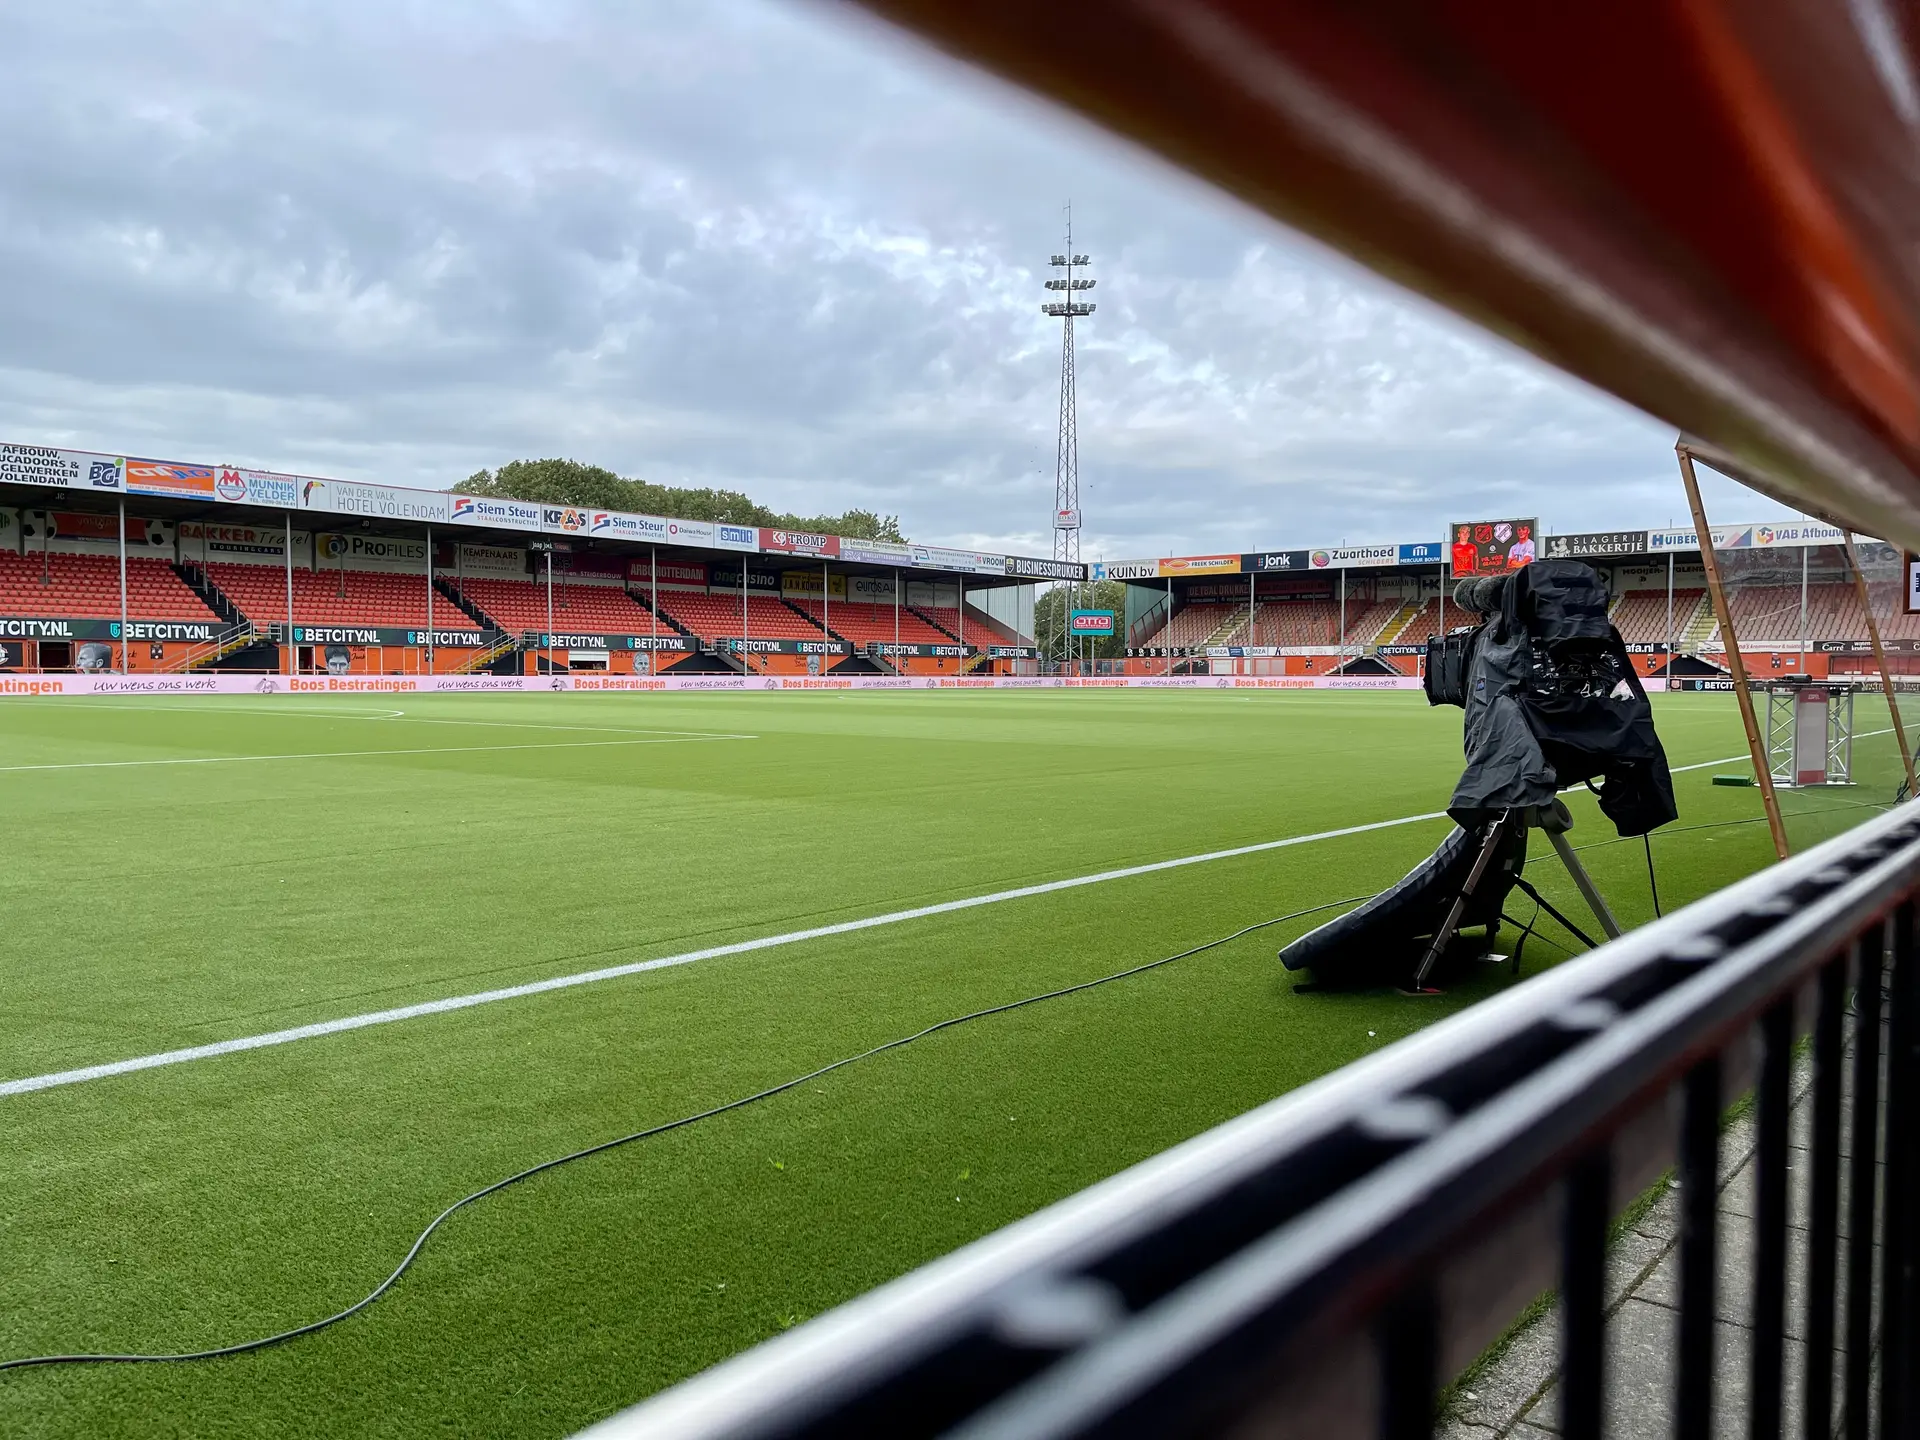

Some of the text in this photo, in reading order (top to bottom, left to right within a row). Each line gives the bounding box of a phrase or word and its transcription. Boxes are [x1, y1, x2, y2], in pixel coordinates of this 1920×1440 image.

[2, 446, 61, 459] AFBOUW,
[70, 461, 80, 469] &
[250, 479, 295, 492] MUNNIK
[250, 488, 296, 501] VELDER
[336, 486, 395, 501] VAN DER VALK
[337, 498, 445, 520] HOTEL VOLENDAM
[477, 502, 538, 519] Siem Steur
[477, 515, 539, 526] STAALCONSTRUCTIES
[613, 517, 665, 532] Siem Steur
[180, 524, 257, 543] BAKKER
[721, 527, 753, 543] smit
[1573, 533, 1643, 545] SLAGERIJ
[1652, 534, 1697, 545] HUIBER
[1776, 529, 1798, 540] VAB
[788, 533, 827, 547] TROMP
[213, 543, 281, 554] TOURINGCARS
[353, 537, 425, 559] PROFILES
[463, 547, 518, 560] KEMPENAARS
[1332, 547, 1394, 560] Zwarthoed
[1573, 542, 1643, 554] BAKKERTJE
[982, 556, 1004, 566] VROOM
[656, 566, 704, 580] ROTTERDAM
[1016, 559, 1084, 579] BUSINESSDRUKKER
[1108, 566, 1154, 578] KUIN bv
[1076, 617, 1109, 625] OTTO
[125, 622, 214, 639] BETCITY.NL
[305, 628, 381, 643] BETCITY.NL
[802, 643, 843, 653] BETCIY.NL
[936, 646, 969, 656] BETCITYNL
[1625, 643, 1654, 653] afa.nl
[1821, 641, 1844, 651] Carré
[120, 680, 154, 690] wens
[157, 680, 181, 690] ons
[185, 678, 216, 689] werk
[290, 678, 416, 692] Boos Bestratingen
[454, 680, 480, 688] wens
[481, 680, 498, 688] ons
[500, 680, 523, 688] werk
[574, 678, 666, 691] Boos Bestratingen
[783, 679, 852, 689] Boos Bestratingen
[940, 679, 994, 688] Boos Bestratingen
[1065, 679, 1129, 688] Boos Bestratingen
[1235, 679, 1314, 688] Boos Bestratingen
[1704, 681, 1735, 689] BETCIT
